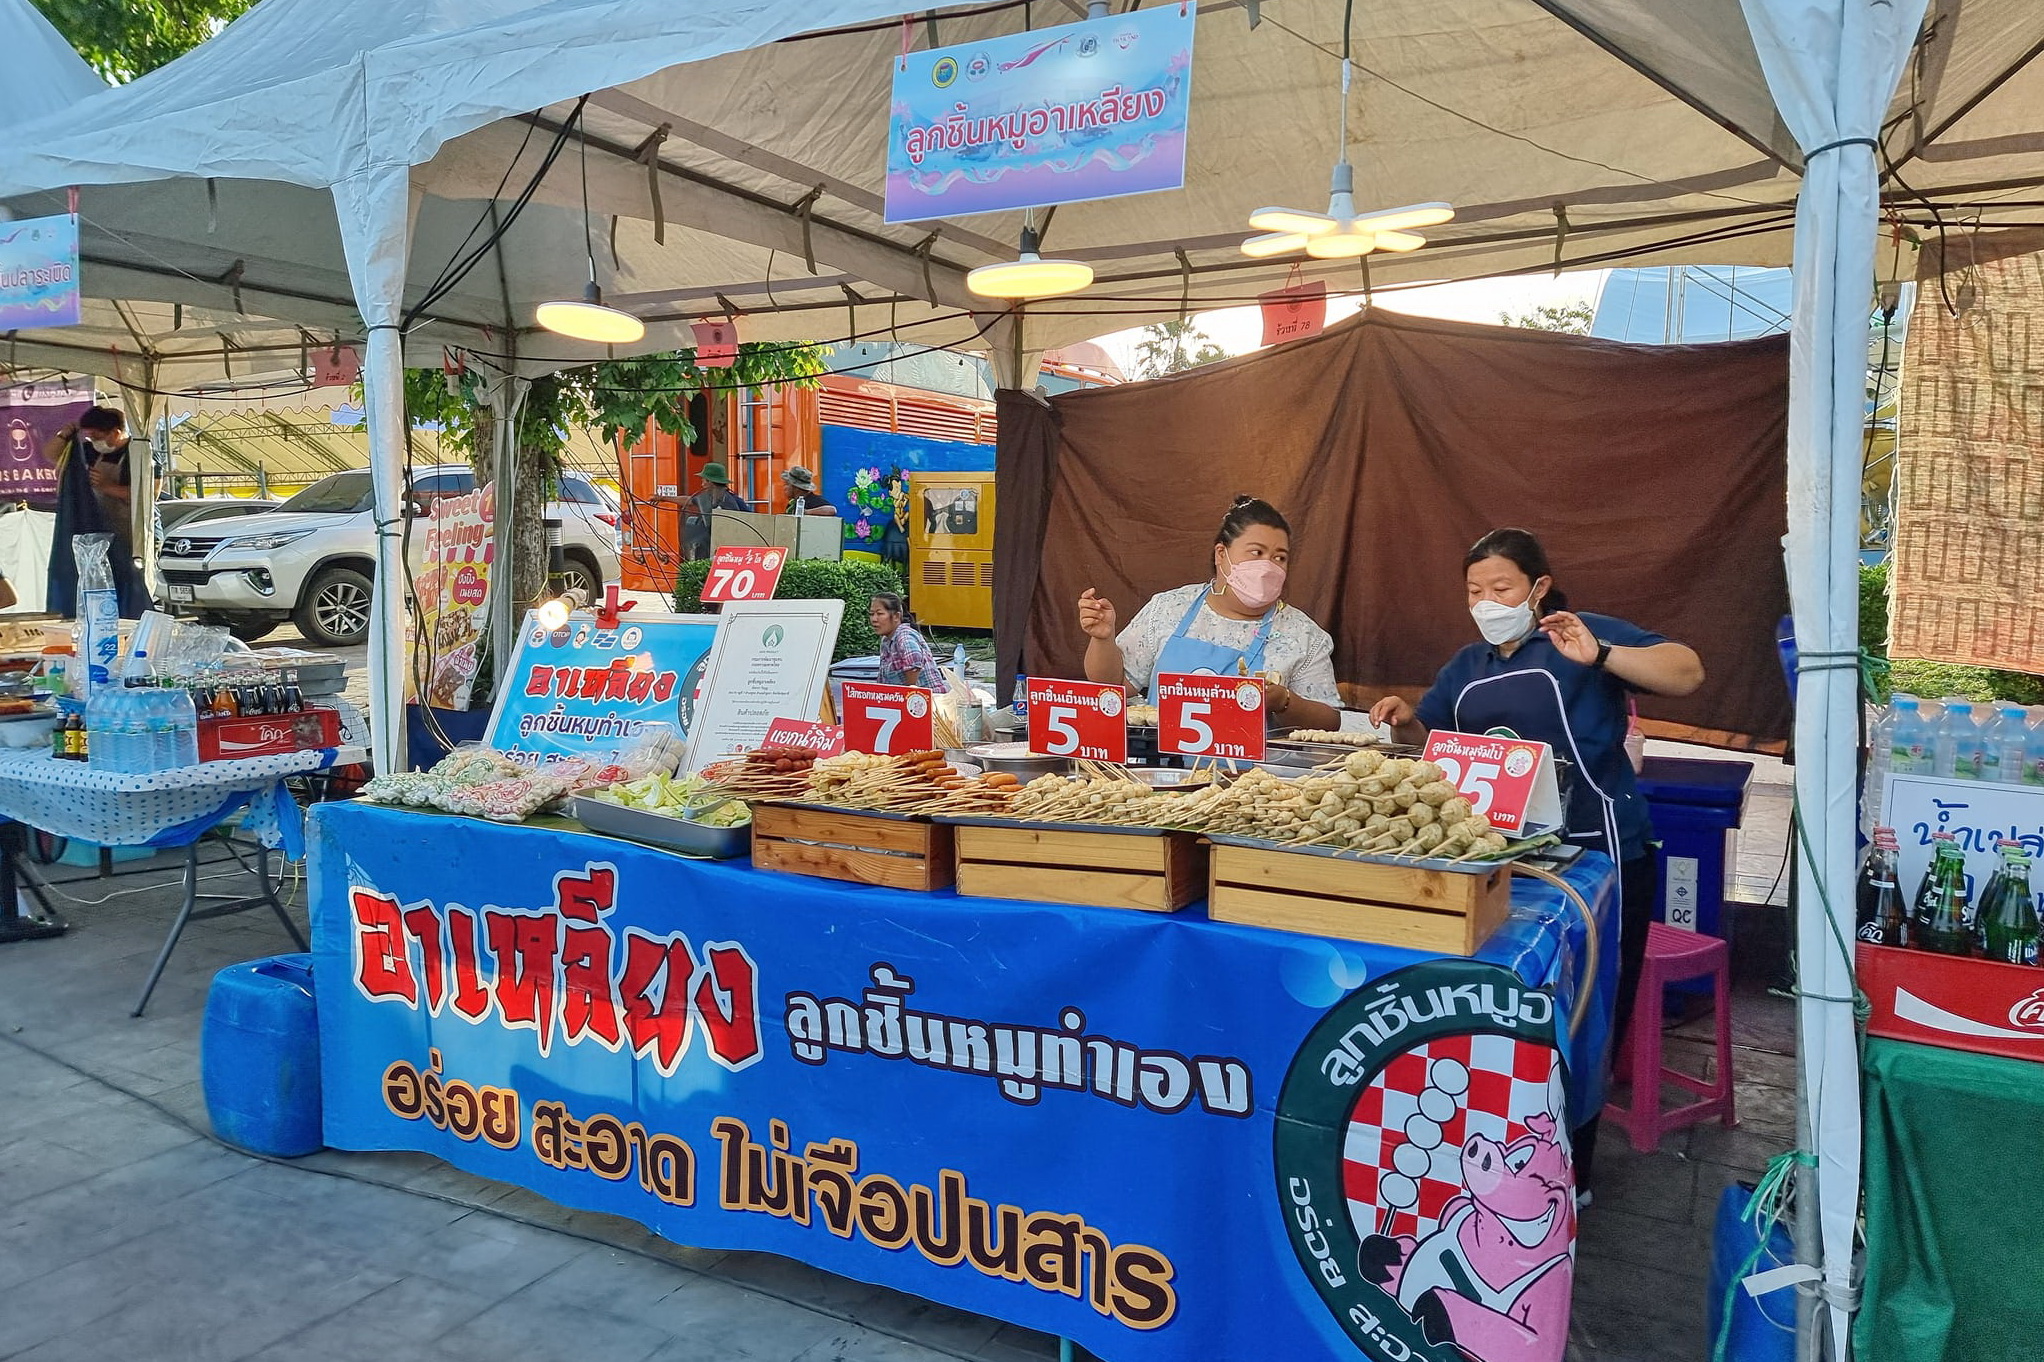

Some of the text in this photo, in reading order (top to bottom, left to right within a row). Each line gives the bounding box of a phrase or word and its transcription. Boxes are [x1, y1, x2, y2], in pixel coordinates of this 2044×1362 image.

[906, 86, 1167, 164] ลูกชิ้นหมูอาเหลียง
[1300, 320, 1311, 331] 78
[430, 489, 480, 521] Sweet
[425, 522, 485, 550] Feeling
[709, 569, 755, 599] 70
[552, 630, 571, 639] OTOP
[1030, 685, 1099, 711] ลูกชิ้นเอ็นหมู
[1159, 677, 1236, 703] ลูกชิ้นหมูล้วน
[770, 724, 836, 751] แยกน้ำจิ้ม
[865, 706, 901, 753] 7
[1046, 706, 1080, 755] 5
[1177, 701, 1213, 753] 5
[1080, 745, 1108, 760] บาท
[1214, 742, 1245, 757] บาท
[1431, 737, 1505, 760] ลูกชิ้นหมูจัมโบ้
[1493, 811, 1516, 823] บาท
[1672, 908, 1692, 924] QC
[349, 862, 763, 1077] อาเหลียง
[786, 962, 1254, 1118] ลูกชิ้นหมูทำเอง
[382, 1049, 1176, 1330] อร่อย สะอาด ไม่เจือปนสาร
[1289, 1177, 1348, 1288] อร่อย
